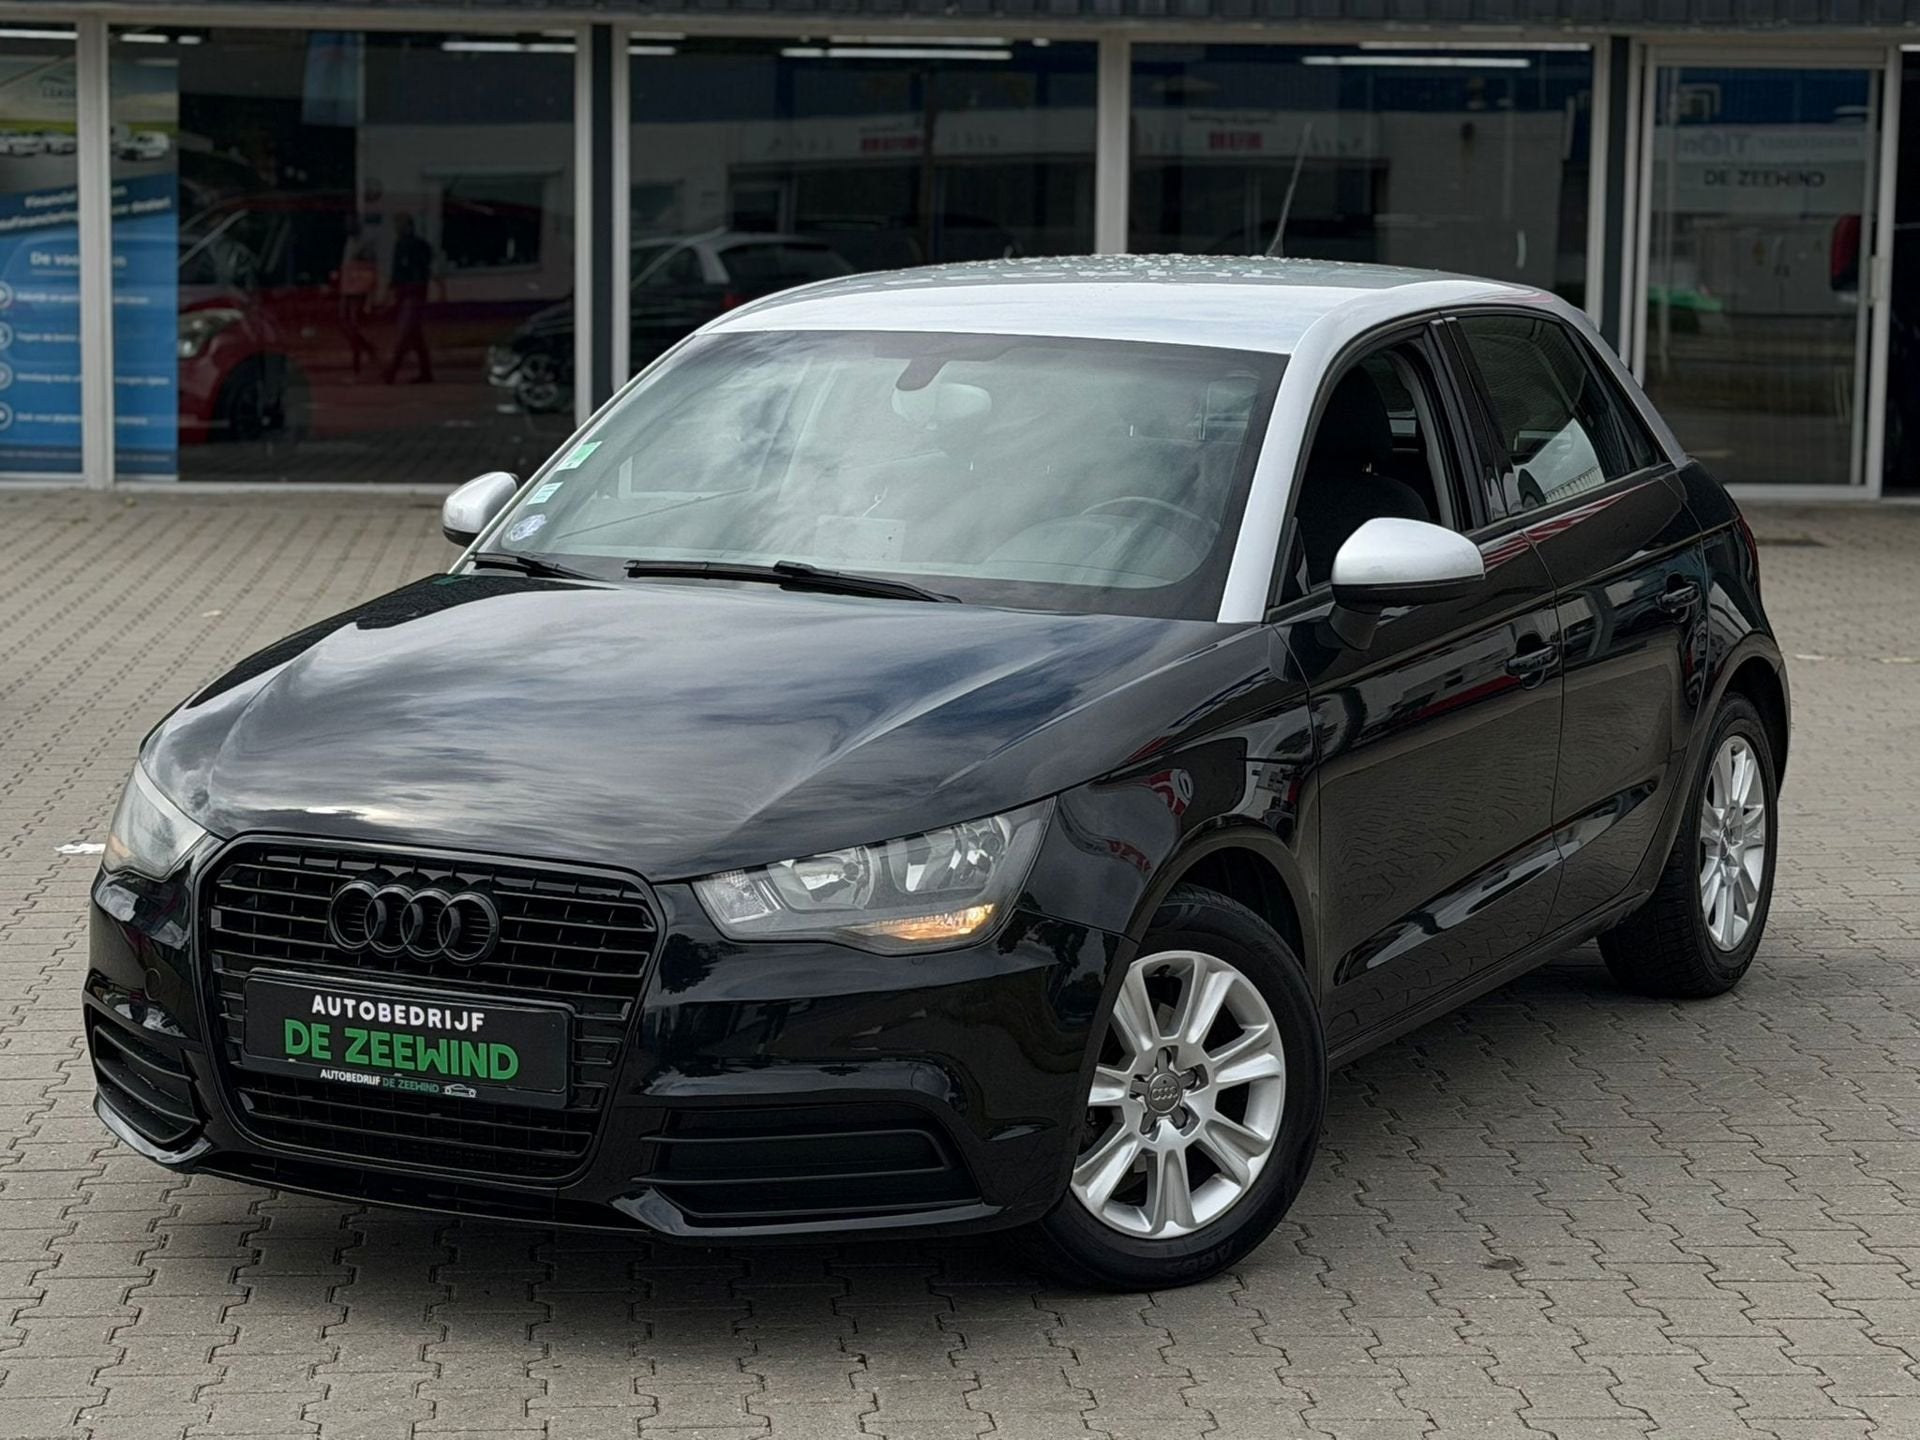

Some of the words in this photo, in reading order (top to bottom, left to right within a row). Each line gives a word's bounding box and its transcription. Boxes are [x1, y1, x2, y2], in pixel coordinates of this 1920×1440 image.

[1703, 169, 1729, 186] DE
[311, 995, 485, 1032] AUTOBEDRIJF
[284, 1019, 332, 1060] DE
[344, 1027, 519, 1080] ZEEWIND
[320, 1069, 381, 1086] AUTOBEDRIJF
[382, 1078, 395, 1088] DE
[398, 1080, 440, 1094] ZEEWIND
